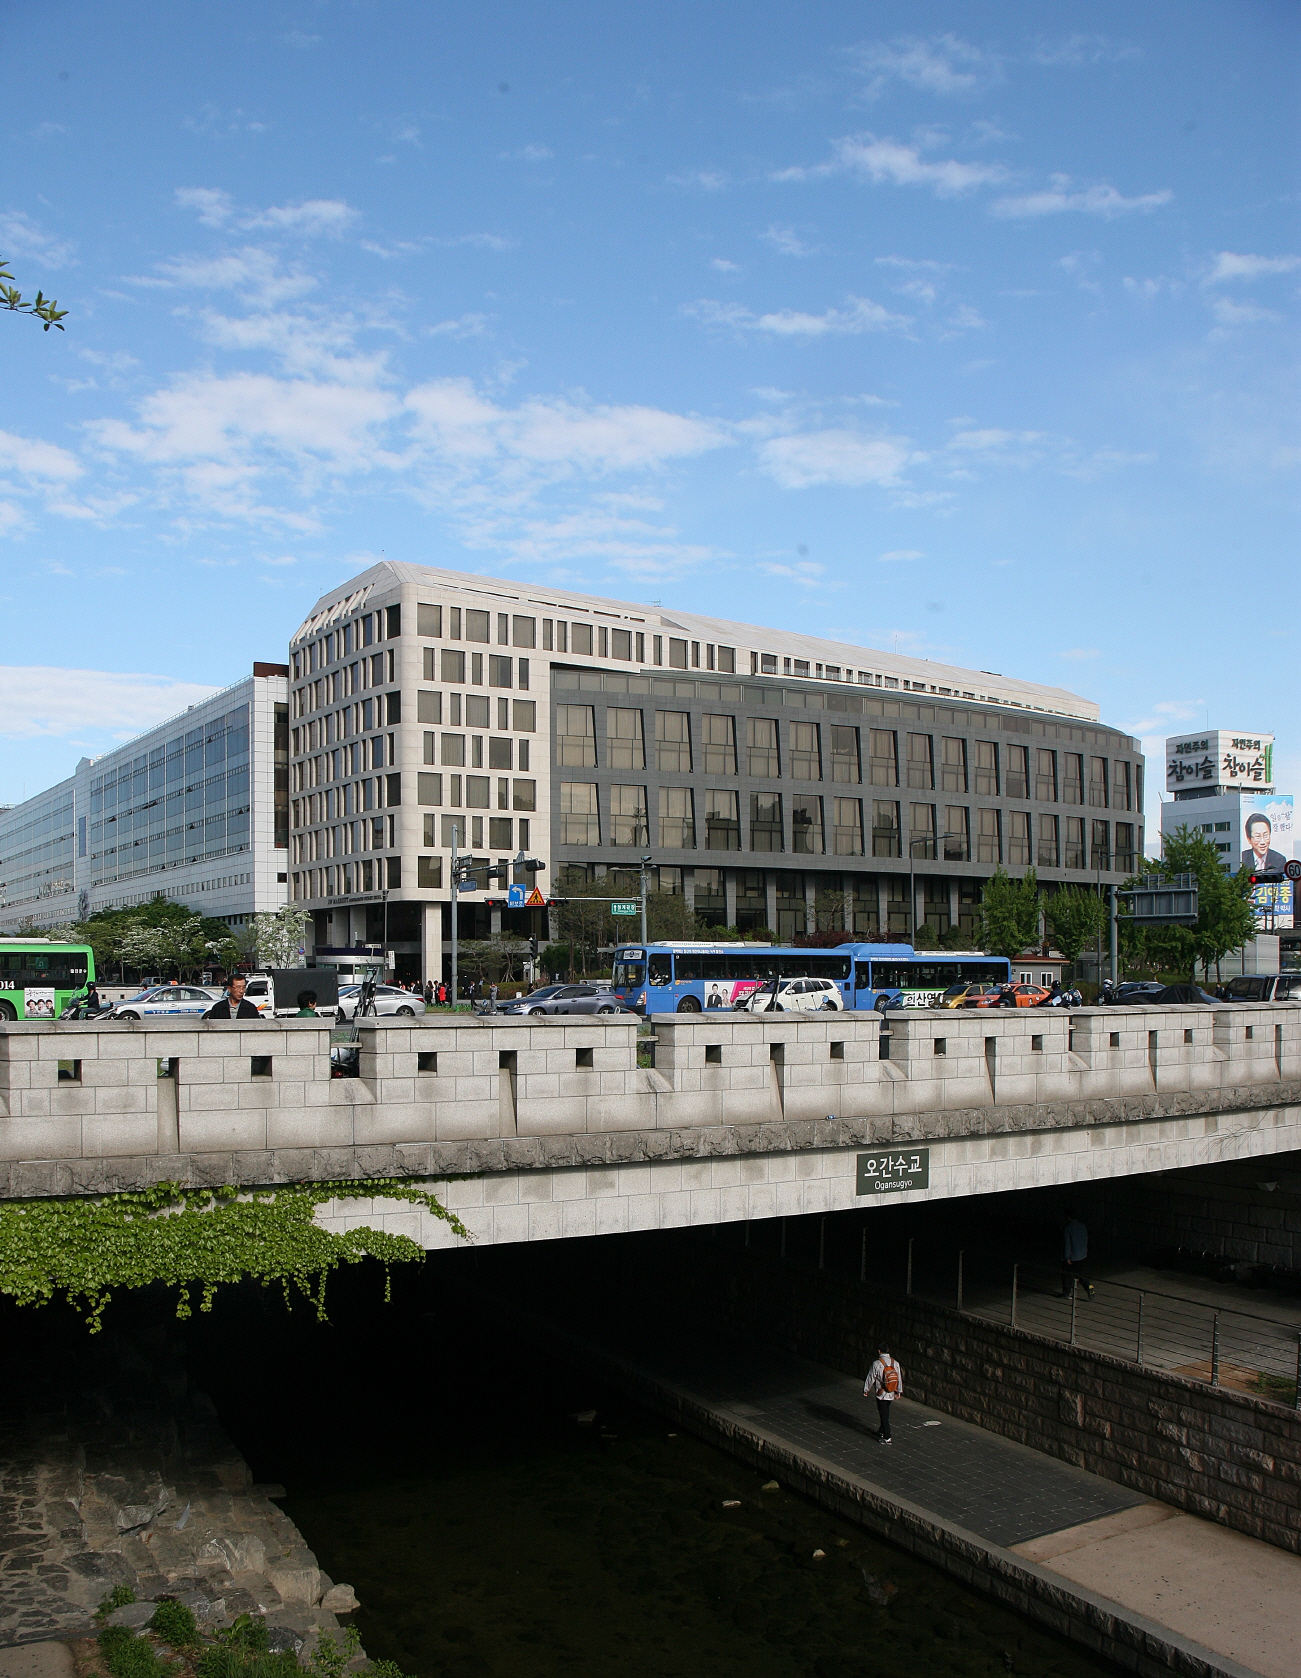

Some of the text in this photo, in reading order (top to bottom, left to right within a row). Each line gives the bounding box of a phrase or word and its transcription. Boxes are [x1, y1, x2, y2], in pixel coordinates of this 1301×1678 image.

[1175, 739, 1209, 754] 자연주의
[1231, 738, 1261, 751] 자연주의
[1167, 755, 1216, 782] 참이슬
[1222, 753, 1265, 781] 참이슬
[1288, 864, 1301, 877] 60
[864, 1155, 923, 1178] 오간수교
[874, 1180, 913, 1191] Ogansugyo
